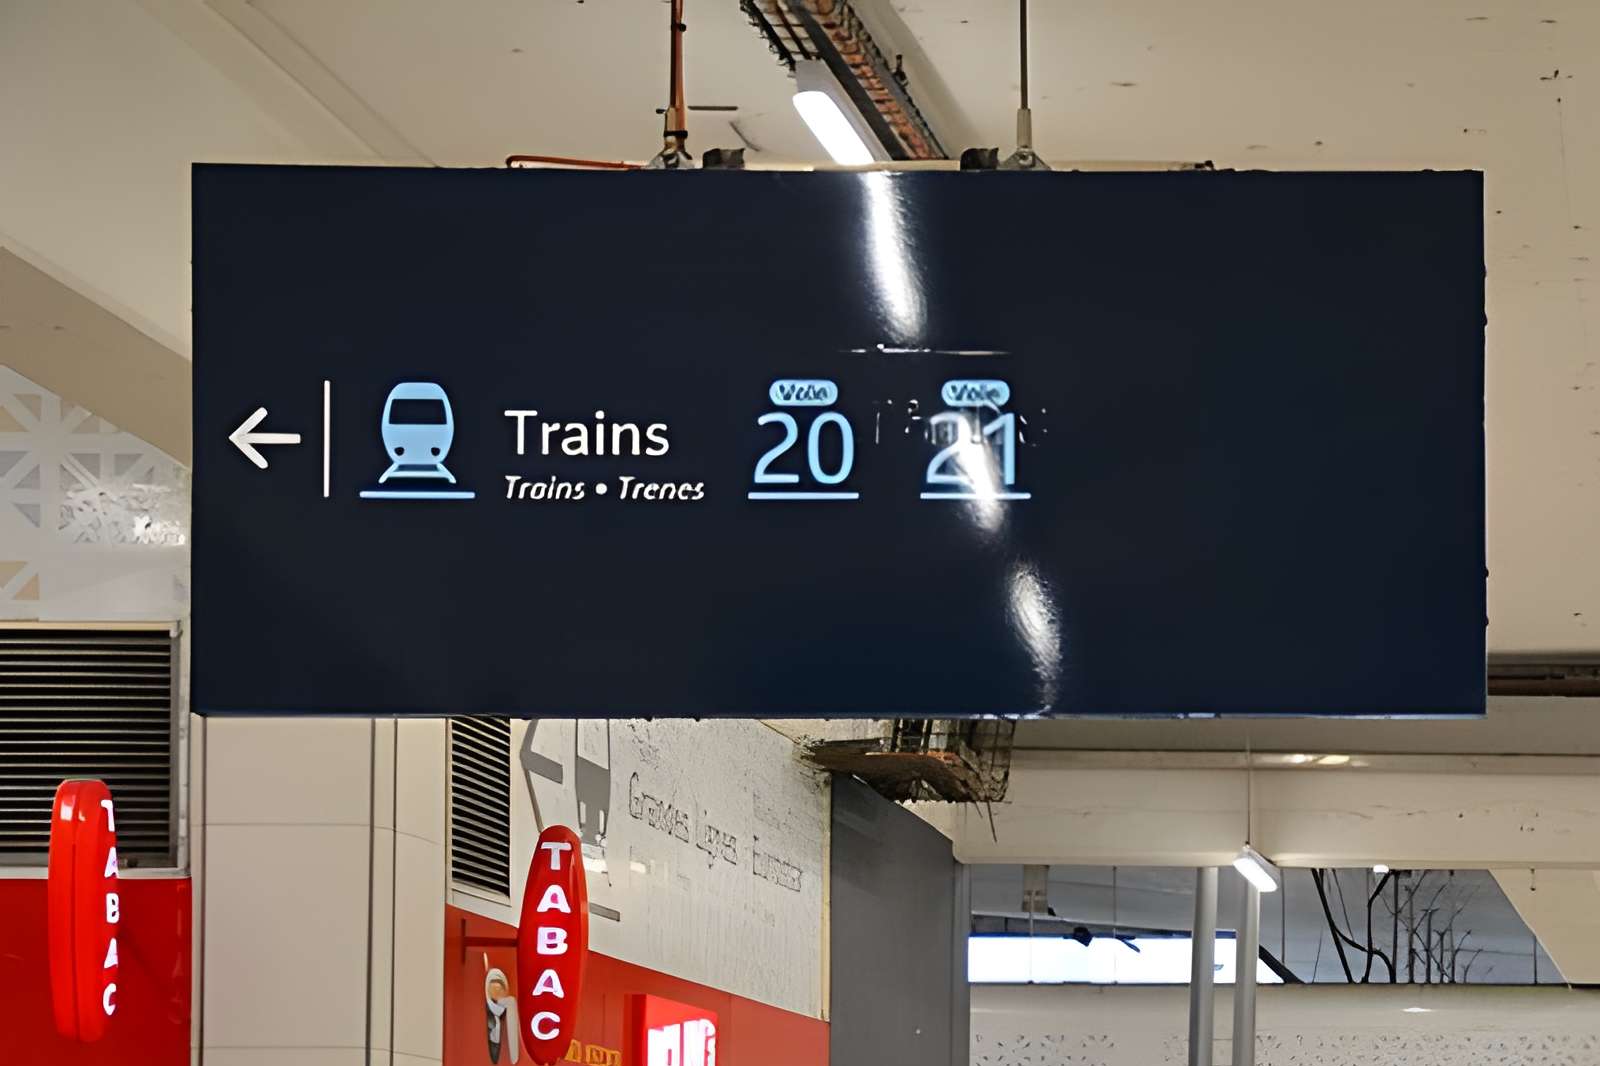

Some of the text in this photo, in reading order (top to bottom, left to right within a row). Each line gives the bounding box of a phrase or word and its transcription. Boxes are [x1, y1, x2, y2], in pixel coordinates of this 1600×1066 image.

[504, 410, 1016, 485] Trains 20 21
[504, 475, 705, 501] Trains Trenes
[530, 842, 572, 1041] TABAC
